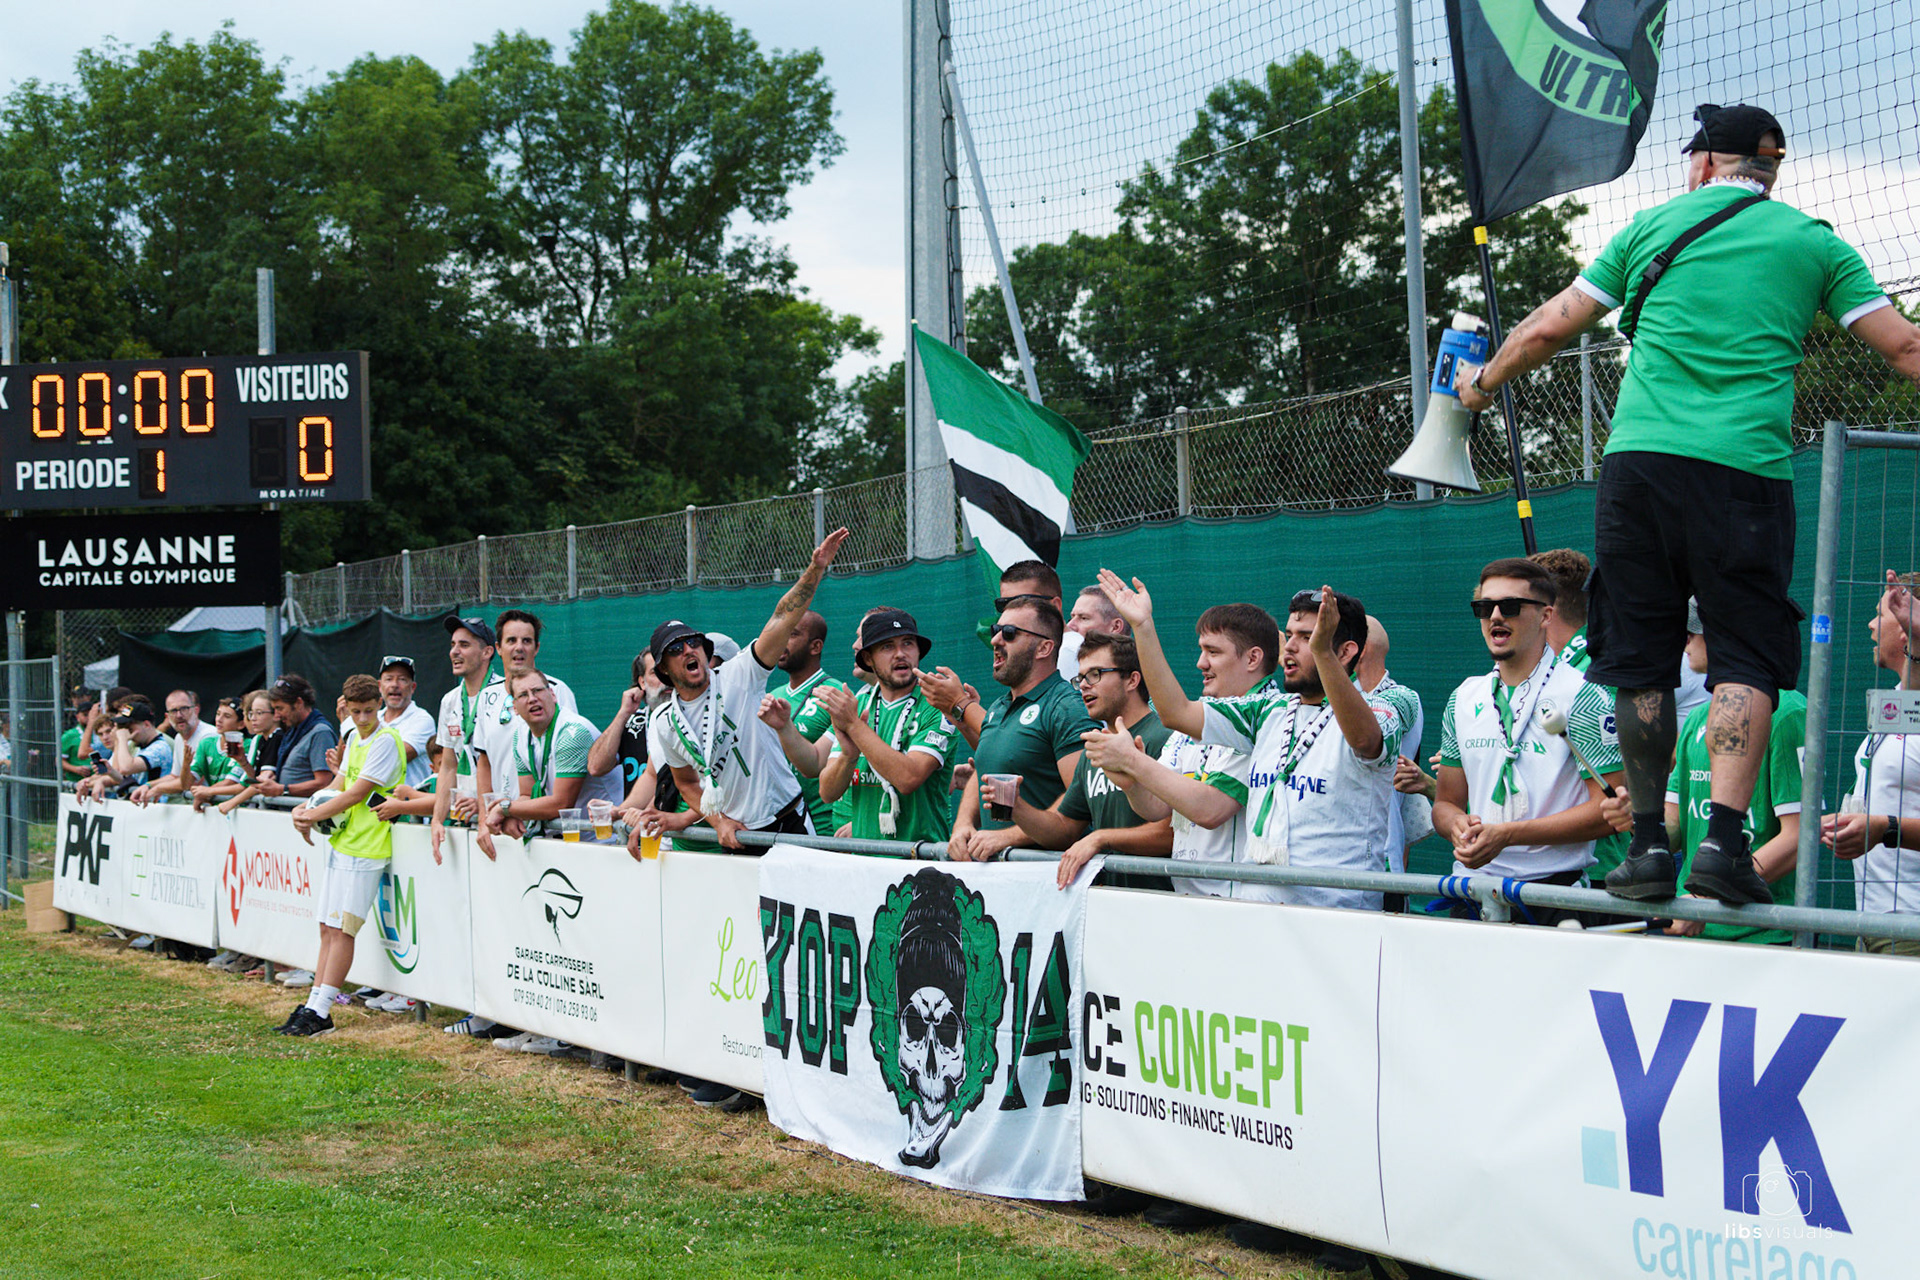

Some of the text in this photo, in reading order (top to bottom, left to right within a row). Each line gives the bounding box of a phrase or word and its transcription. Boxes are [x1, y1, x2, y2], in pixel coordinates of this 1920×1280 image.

[1540, 44, 1635, 118] ULTR
[32, 368, 214, 438] 00:00
[236, 363, 349, 402] VISITEURS
[299, 416, 333, 482] 0
[16, 457, 130, 491] PERIODE
[156, 450, 165, 493] 1
[259, 488, 326, 499] MOBATIME
[38, 535, 236, 567] LAUSANNE
[39, 567, 236, 587] CAPITALE OLYMPIQUE
[1465, 738, 1497, 749] CREDIT
[61, 810, 114, 885] PKF
[244, 849, 311, 898] MORINA SA
[507, 963, 520, 980] DE
[523, 967, 534, 983] LA
[537, 970, 576, 993] COLLINE
[515, 947, 594, 975] GARAGE CARROSSERIE
[514, 988, 524, 1003] 079
[536, 994, 543, 1008] 40
[545, 996, 552, 1010] 21
[556, 998, 566, 1014] 076
[568, 1002, 579, 1018] 258
[581, 1004, 588, 1020] 93
[589, 1006, 597, 1022] 06
[760, 896, 1072, 1111] KOP 14
[1134, 1000, 1310, 1116] CONCEPT
[1097, 1085, 1166, 1122] SOLUTIONS
[1171, 1102, 1226, 1136] FINANCE
[1231, 1114, 1293, 1151] VALEURS
[1589, 989, 1853, 1234] YK
